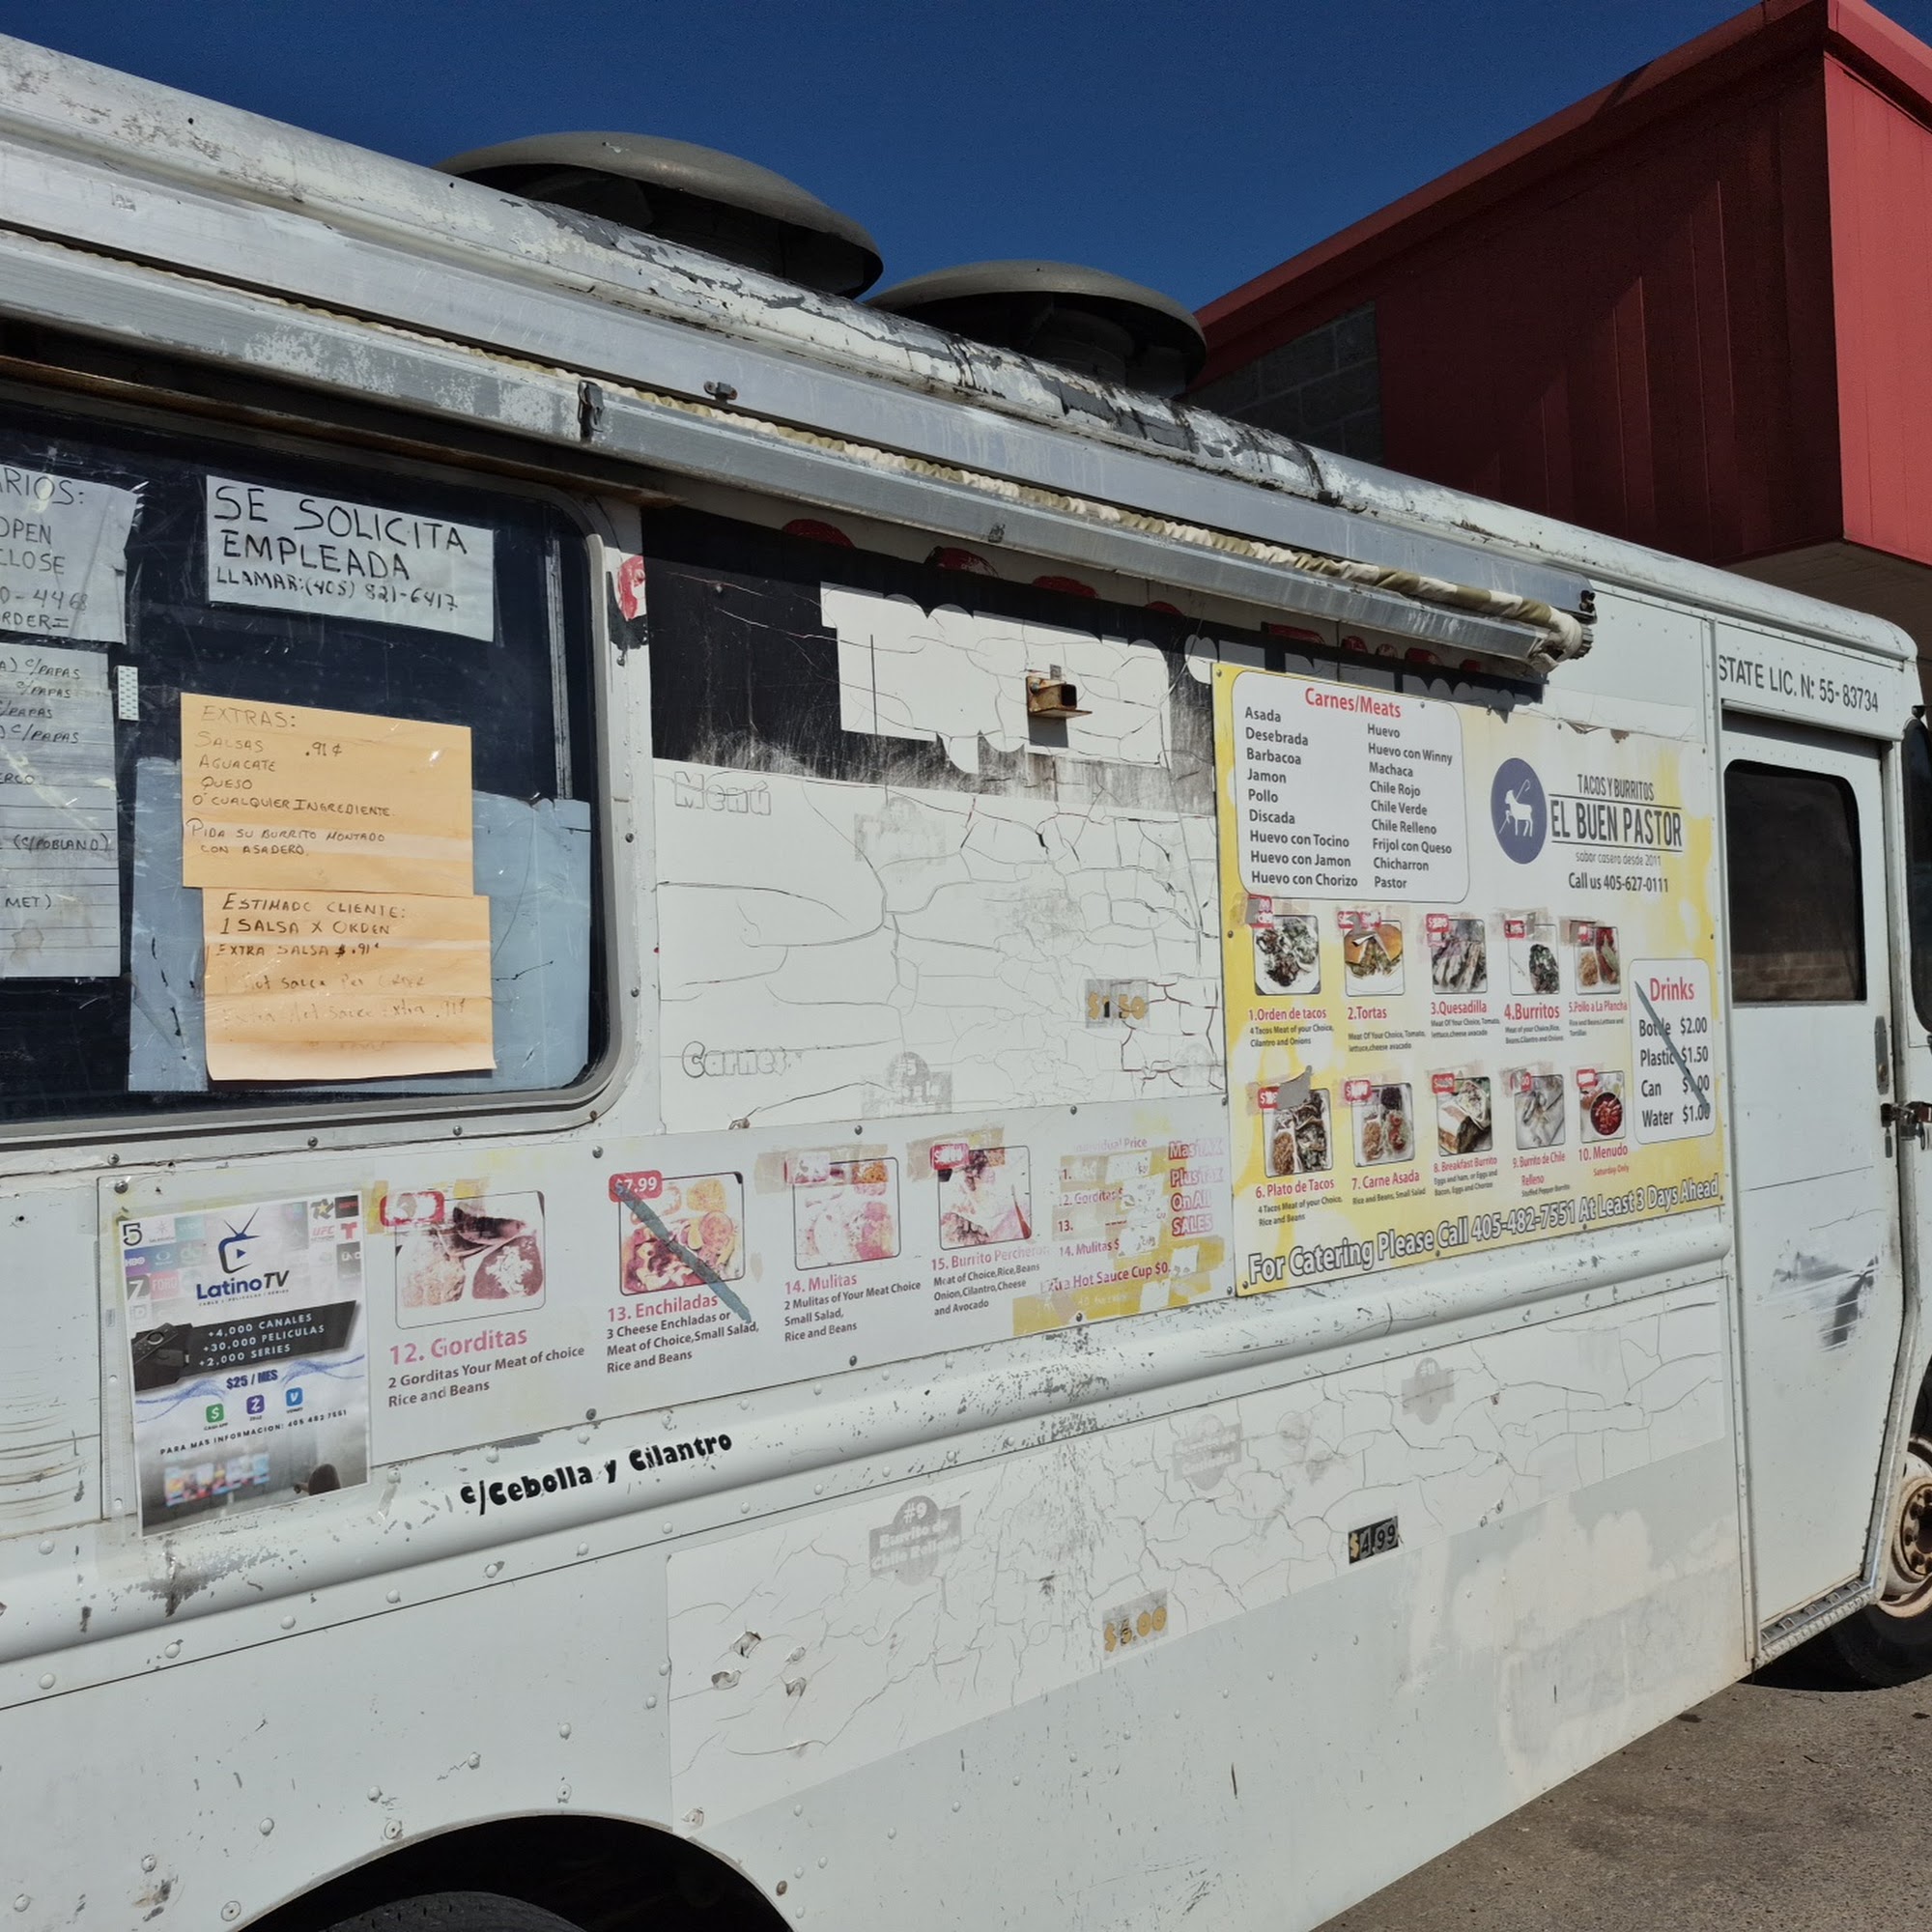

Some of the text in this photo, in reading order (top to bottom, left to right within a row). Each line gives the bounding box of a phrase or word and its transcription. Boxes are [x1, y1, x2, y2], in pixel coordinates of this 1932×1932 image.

[0, 468, 84, 505] RIOS:
[214, 486, 468, 554] SE SOLICITA
[221, 529, 410, 580] EMPLEADA
[1719, 655, 1797, 696] STATE LIC.
[1304, 687, 1402, 718] Carnes/Meats
[201, 705, 296, 728] EXTRAS:
[1245, 706, 1282, 723] Asada
[1245, 727, 1309, 746] Desebrada
[1367, 724, 1401, 739] Huevo
[199, 754, 276, 772] AGUACATE
[1246, 748, 1302, 765] Barbacoa
[1368, 743, 1453, 766] Huevo con Winny
[1247, 768, 1287, 783] Jamon
[1369, 761, 1413, 778] Machaca
[201, 777, 253, 790] QUESO
[1370, 781, 1421, 798] Chile Rojo
[1577, 774, 1655, 802] TACOS BURRITOS
[1248, 788, 1279, 803] Pollo
[1371, 800, 1428, 815] Chile Verde
[1249, 809, 1296, 825] Discada
[1549, 800, 1682, 846] EL BUEN PASTOR
[261, 830, 317, 839] BURRITO
[326, 831, 385, 842] MONTADO
[1372, 819, 1437, 836] Chile Relleno
[1250, 830, 1350, 847] Huevo con Tocino
[1372, 838, 1452, 855] Frijol con Queso
[200, 845, 229, 854] CON
[1251, 850, 1351, 867] Huevo con Jamon
[1576, 850, 1662, 867] sabor casero desde 2011
[1373, 857, 1430, 871] Chicharron
[1251, 870, 1358, 887] Huevo con Chorizo
[1374, 876, 1407, 889] Pastor
[1568, 872, 1668, 893] Call us 405-627-0111
[238, 919, 299, 934] SALSA
[1649, 977, 1694, 1002] Drinks
[1289, 1007, 1327, 1020] de tacos
[1431, 999, 1488, 1015] 3.Quesadilla
[1504, 1002, 1560, 1020] 4.Burritos
[1680, 1016, 1708, 1037] $2.00
[1640, 1045, 1709, 1067] Plastic $1.50
[1641, 1079, 1662, 1097] Can
[1641, 1110, 1673, 1127] Water
[1123, 1137, 1148, 1149] Price
[1578, 1143, 1629, 1162] 10. Menudo
[1441, 1156, 1498, 1172] Breakfast Burrito
[614, 1176, 658, 1194] $7.99
[1267, 1178, 1335, 1197] Plato de Tacos
[1362, 1169, 1420, 1189] Carne Asada
[1521, 1174, 1545, 1187] Relleno
[1172, 1214, 1213, 1236] SALES
[1248, 1172, 1719, 1286] For Catering Please Call 405-482-7551 At Least Days Ahead
[952, 1251, 992, 1268] Burrito
[784, 1273, 858, 1295] 14. Mulitas
[934, 1276, 955, 1288] Meat
[1073, 1264, 1152, 1290] Hot Sauce Cup
[792, 1280, 922, 1310] Mulitas Your Meat Choice
[608, 1293, 719, 1322] 13. Enchiladas
[934, 1298, 989, 1316] and Avocado
[258, 1313, 312, 1329] CANALES
[617, 1321, 658, 1338] Cheese
[719, 1311, 731, 1321] or
[784, 1313, 812, 1326] Small
[262, 1324, 325, 1343] PELICULAS
[784, 1321, 858, 1342] Rice Beans
[250, 1344, 291, 1359] SERIES
[389, 1329, 528, 1365] 12. Gorditas
[607, 1338, 651, 1357] Meat of
[400, 1346, 585, 1387] Gorditas Your Meat of choice
[607, 1350, 693, 1374] Rice and Beans
[226, 1376, 248, 1390] $25
[388, 1379, 491, 1407] Rice and Beans
[160, 1444, 186, 1456] PARA
[190, 1438, 211, 1449] MAS
[213, 1423, 285, 1443] INFORMACION:
[459, 1465, 592, 1516] c/Cebolla
[628, 1434, 732, 1471] Cilantro
